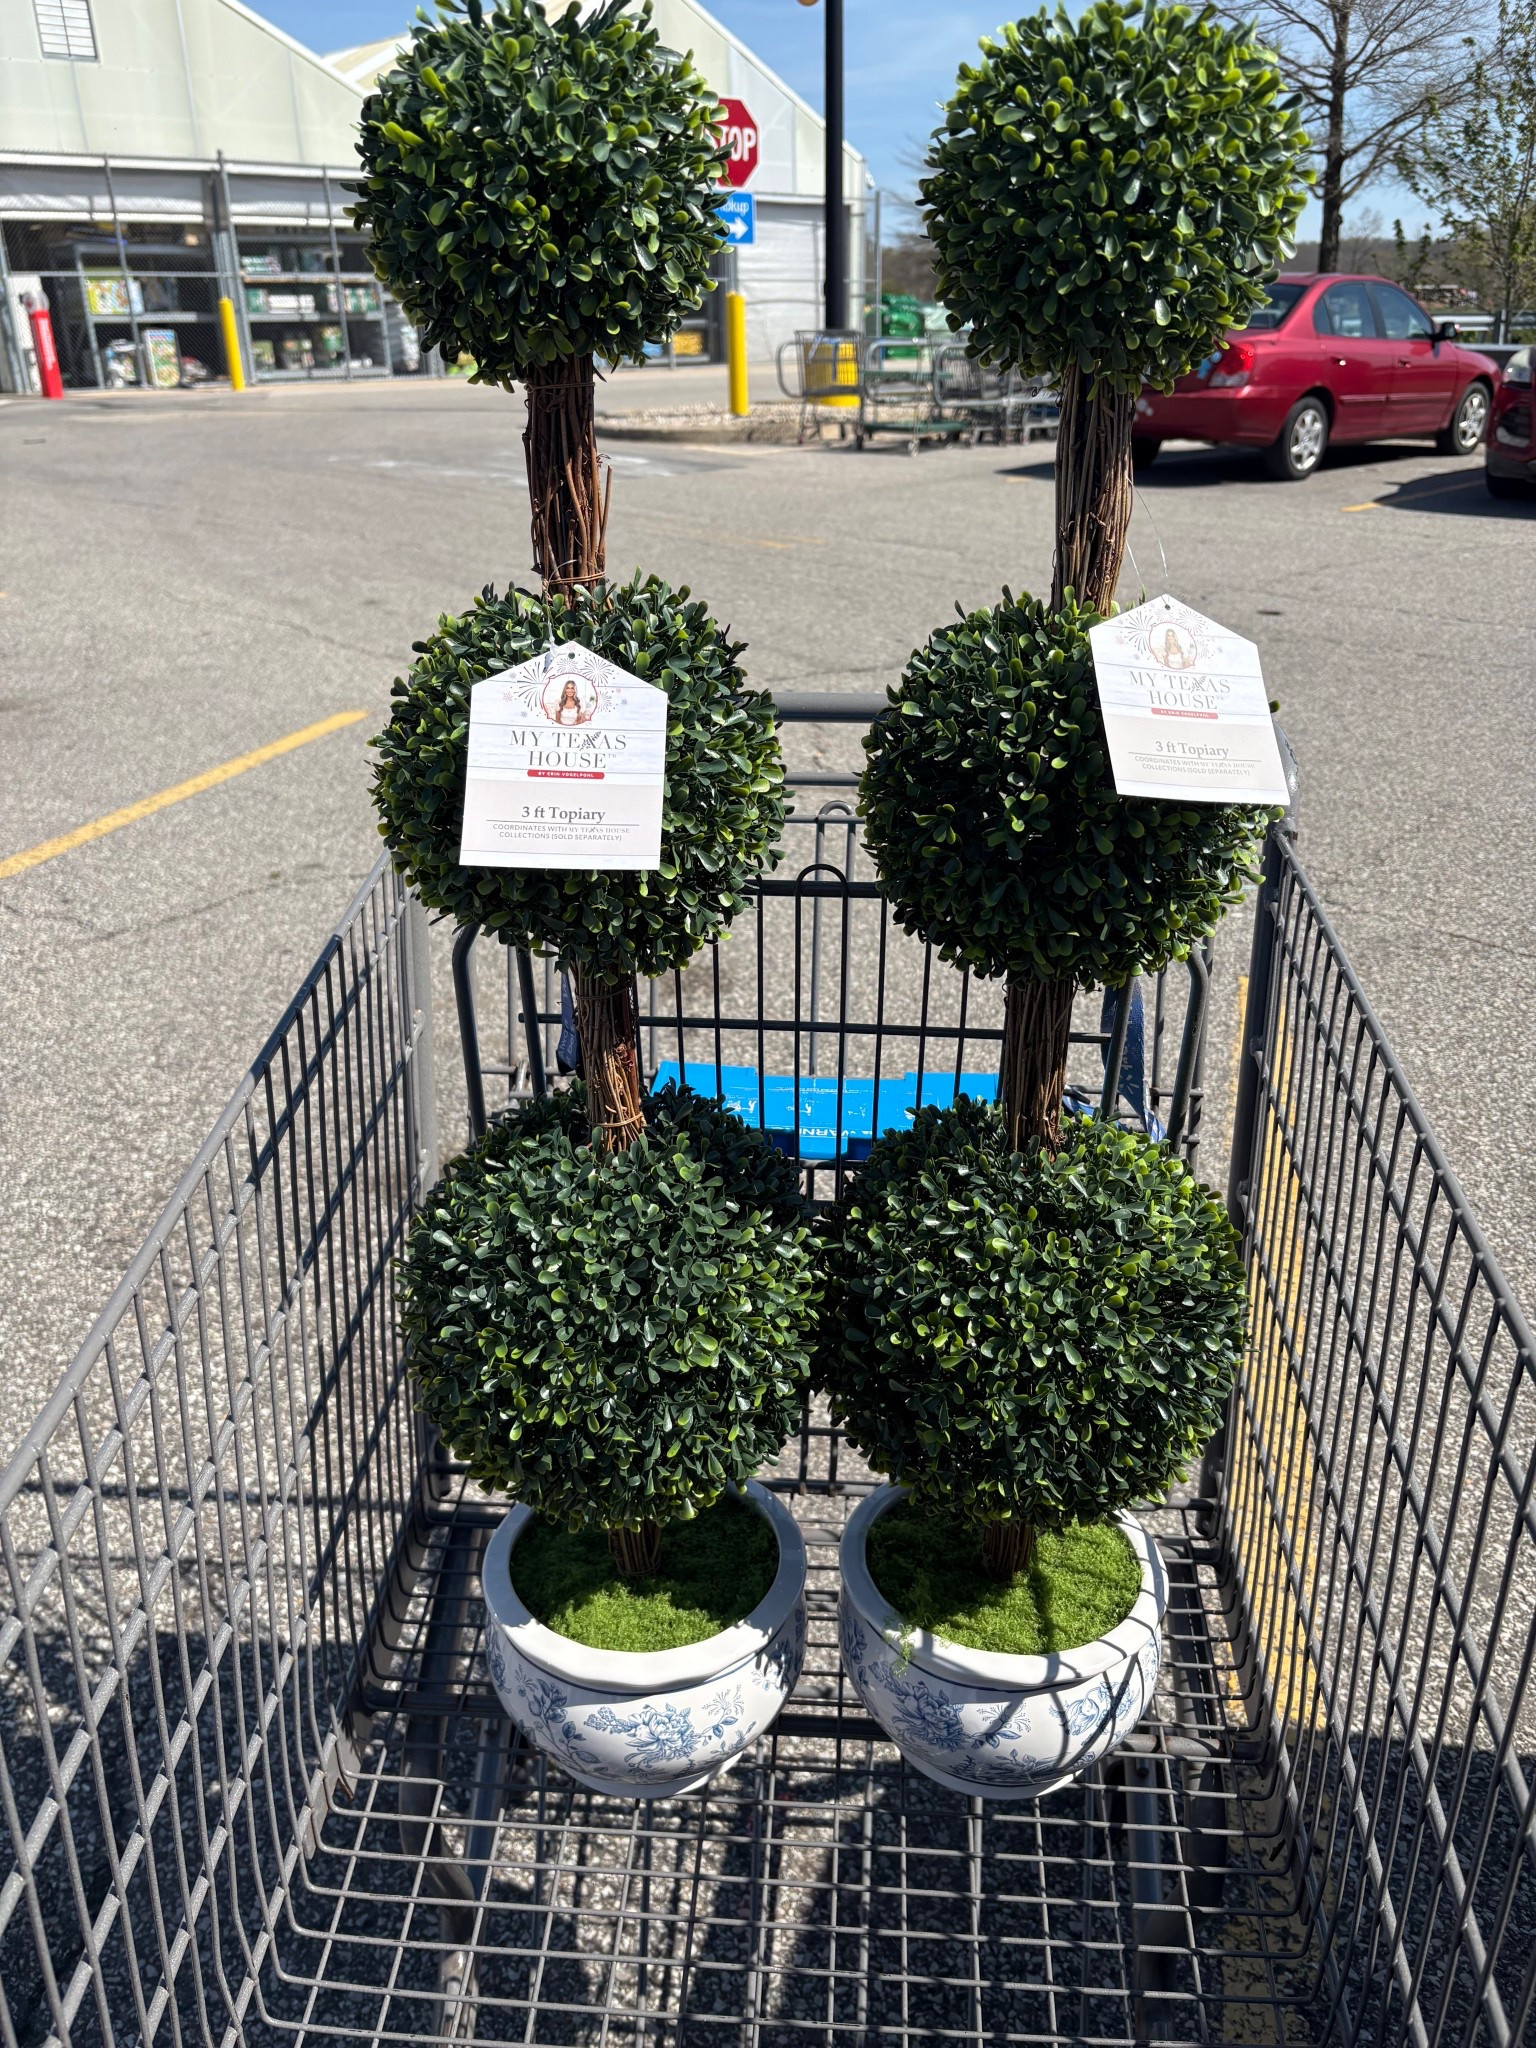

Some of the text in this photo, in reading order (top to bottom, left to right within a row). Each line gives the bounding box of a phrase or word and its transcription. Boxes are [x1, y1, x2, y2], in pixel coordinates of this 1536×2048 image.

[705, 125, 757, 162] TOP
[1129, 671, 1230, 694] MY TEXAS
[509, 730, 627, 750] MY TEXAS
[1155, 741, 1229, 760] 3 ft Topiary
[1134, 755, 1181, 766] COORDINATES
[1142, 763, 1186, 773] COLLECTIONS
[521, 805, 606, 824] 3 ft Topiary
[492, 823, 546, 832] COORDINATES
[499, 831, 550, 840] COLLECTIONS
